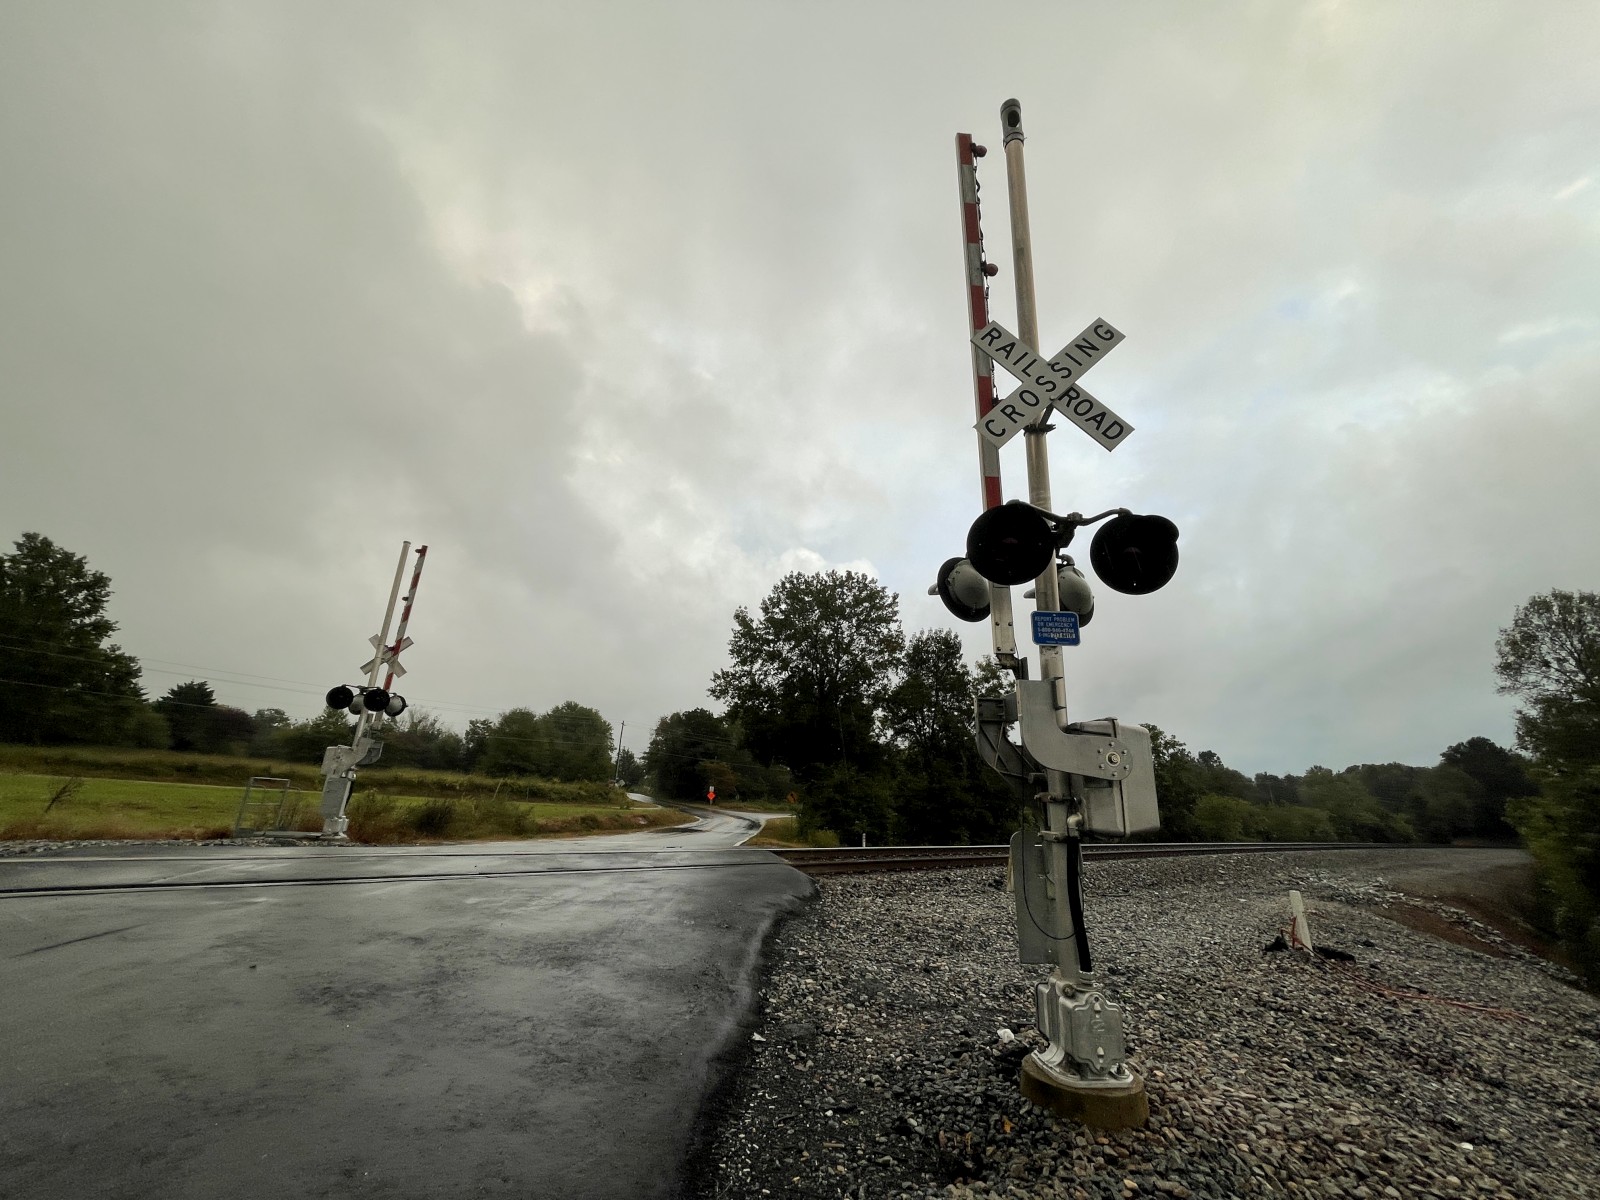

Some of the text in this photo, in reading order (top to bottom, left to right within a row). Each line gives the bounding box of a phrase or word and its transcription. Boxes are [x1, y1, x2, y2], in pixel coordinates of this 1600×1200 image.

[980, 327, 1125, 440] RAIL ROAD
[984, 324, 1115, 437] CROSSING
